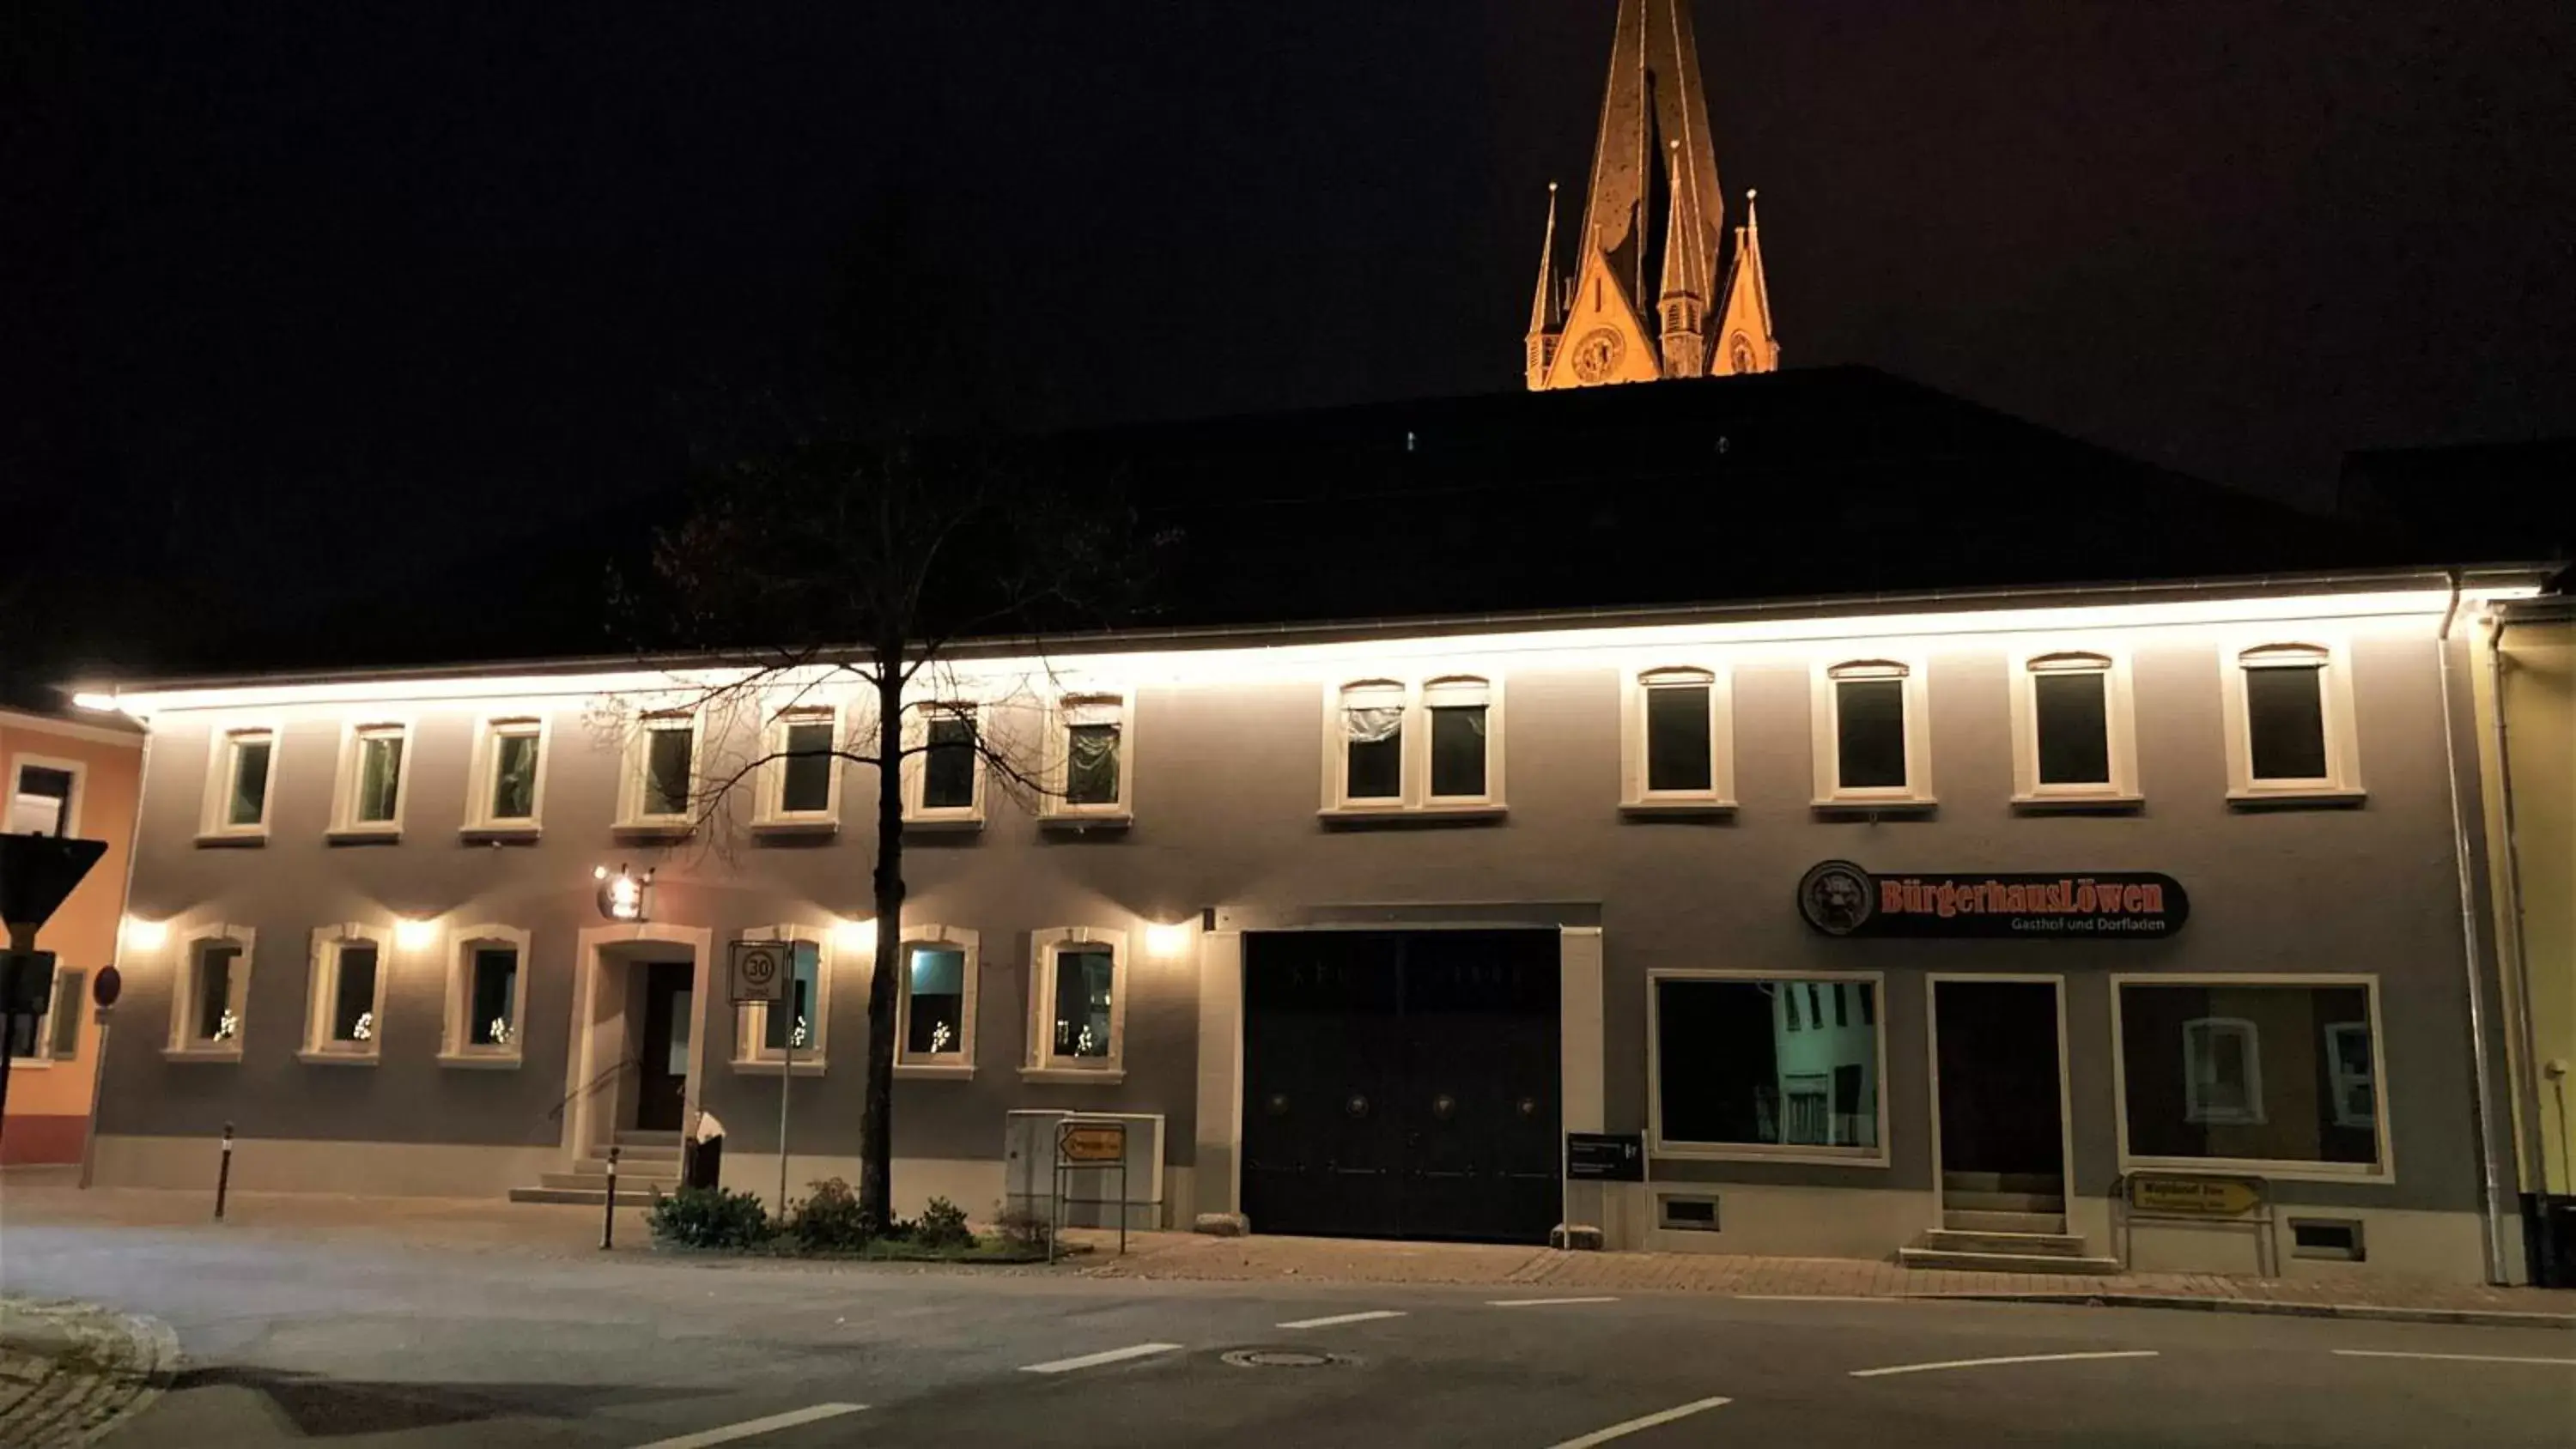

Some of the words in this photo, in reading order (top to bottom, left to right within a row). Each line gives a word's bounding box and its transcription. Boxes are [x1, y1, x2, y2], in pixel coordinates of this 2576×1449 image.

[2011, 917, 2065, 931] Gasthof
[2067, 918, 2094, 931] und
[2098, 918, 2166, 931] Dorfladen
[750, 960, 769, 976] 30
